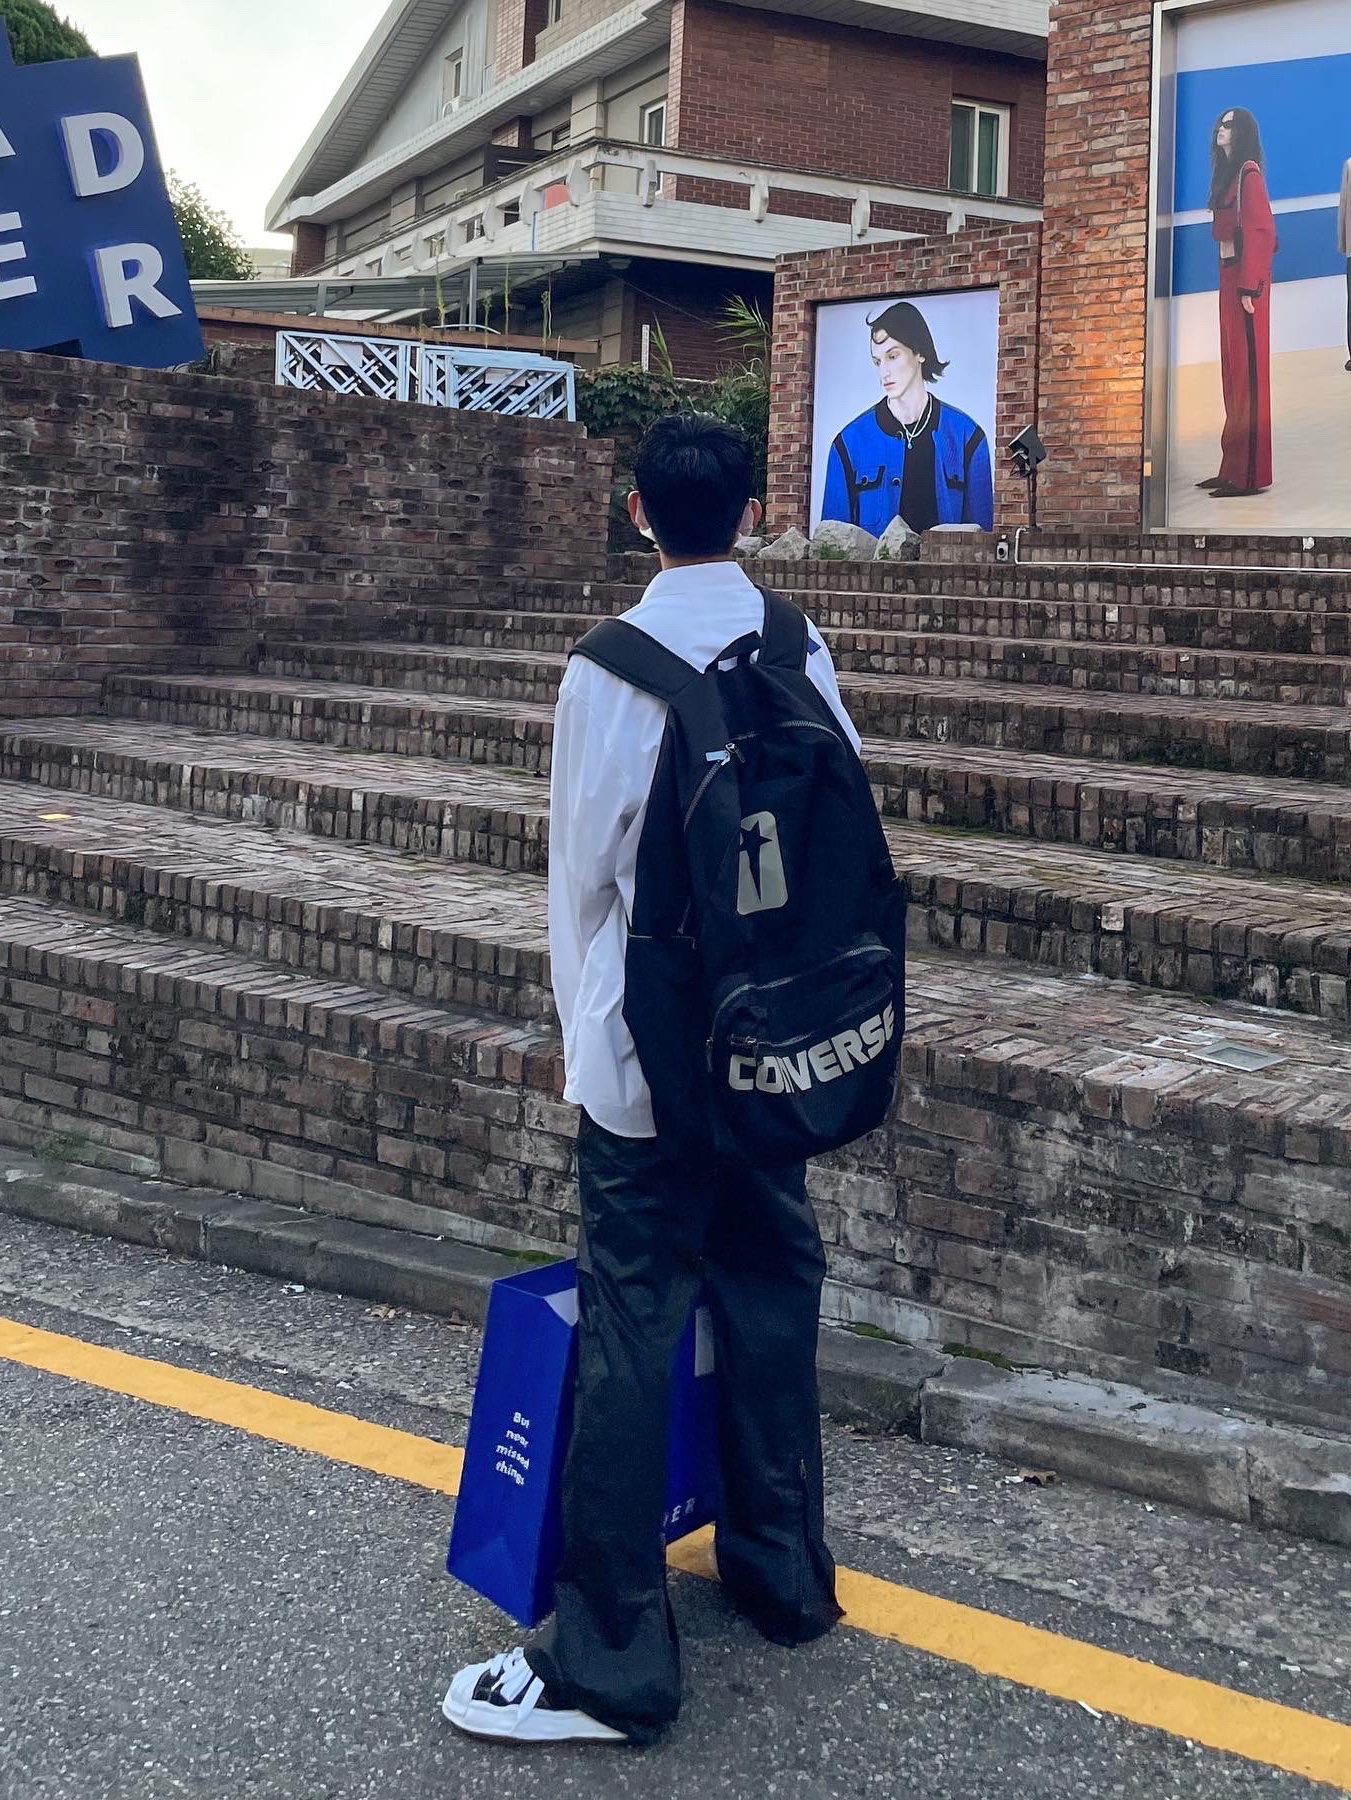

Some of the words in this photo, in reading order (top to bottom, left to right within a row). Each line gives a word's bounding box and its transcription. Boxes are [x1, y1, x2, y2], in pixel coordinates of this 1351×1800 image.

[0, 112, 144, 197] D
[496, 1445, 529, 1470] missed
[495, 1461, 525, 1485] things
[663, 1497, 696, 1527] ER
